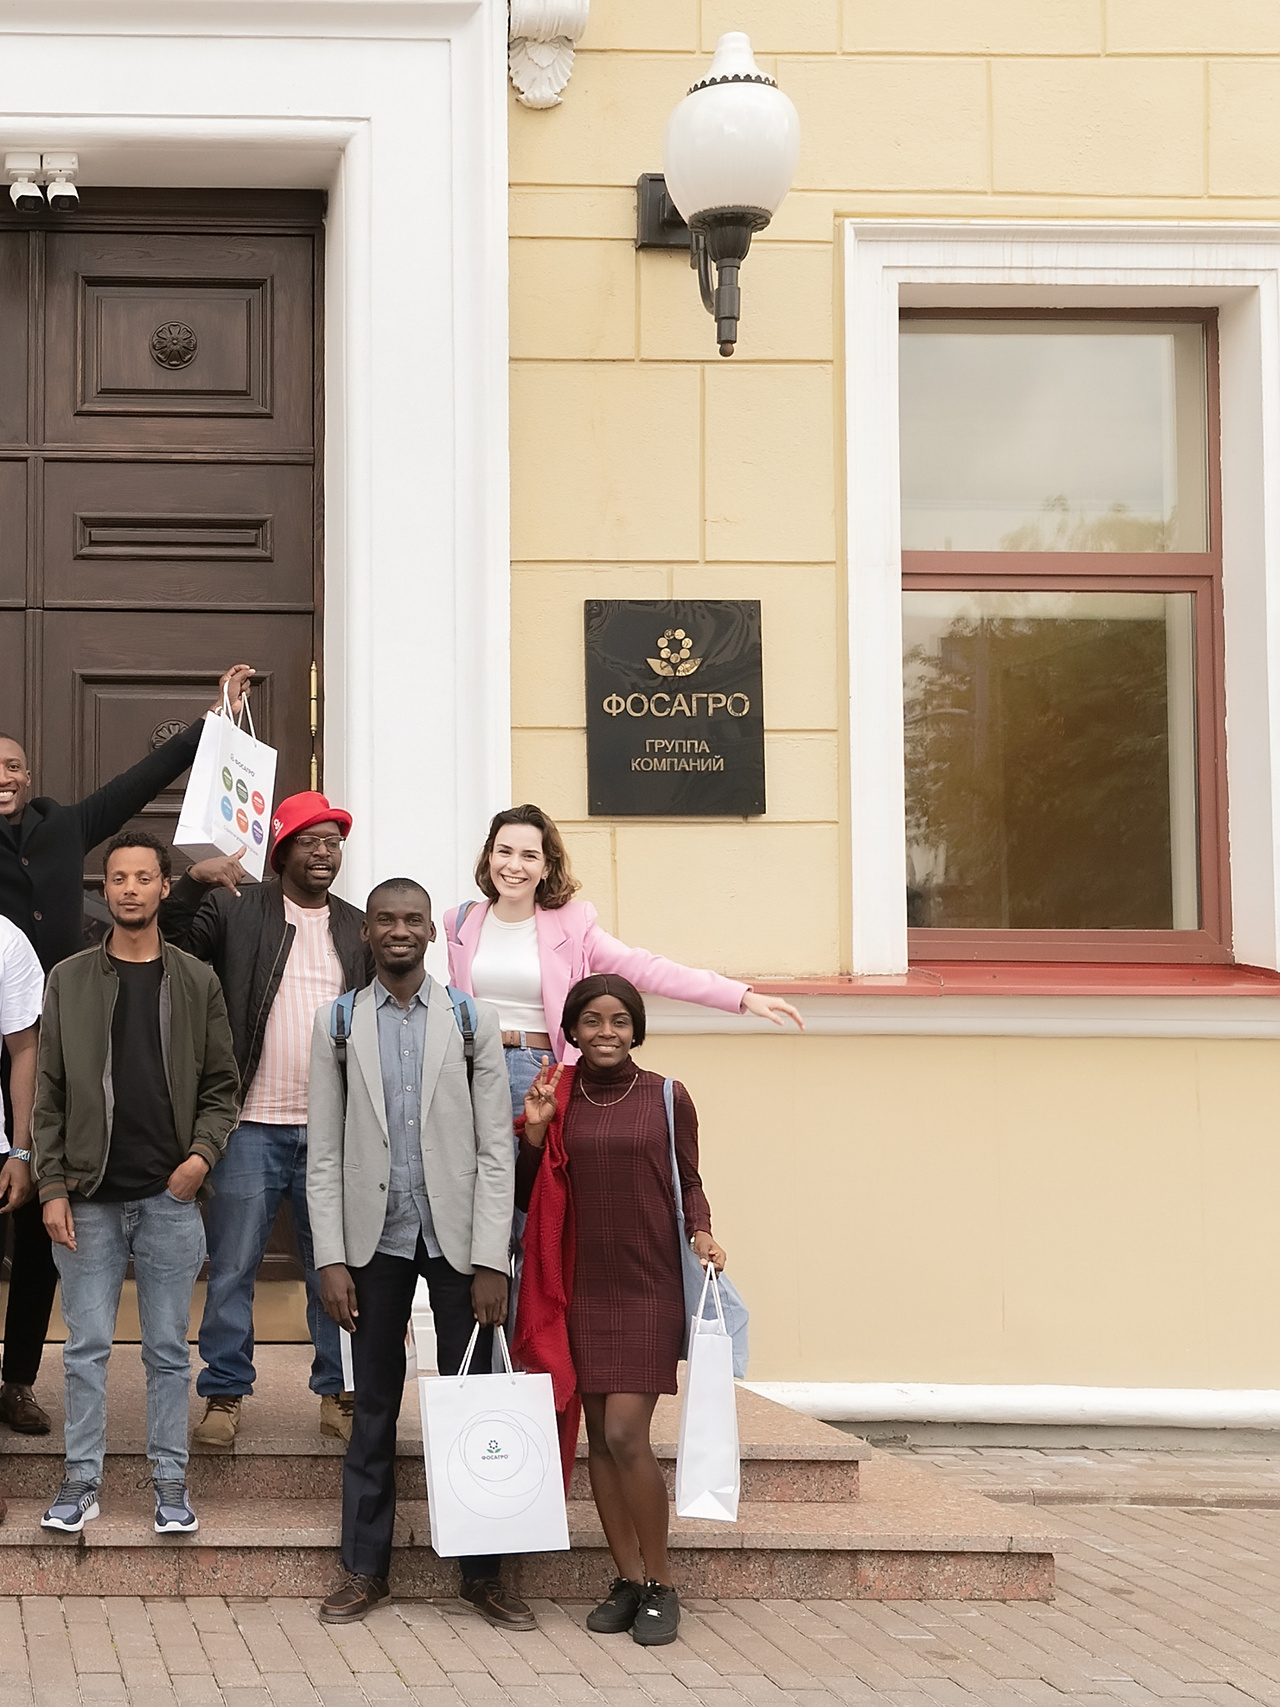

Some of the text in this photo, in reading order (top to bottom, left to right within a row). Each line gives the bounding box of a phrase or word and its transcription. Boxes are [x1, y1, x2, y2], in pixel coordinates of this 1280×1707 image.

[602, 692, 750, 717] ФОСАГРО
[646, 740, 710, 754] ГРУППА
[631, 755, 724, 771] КОМПАНИЙ
